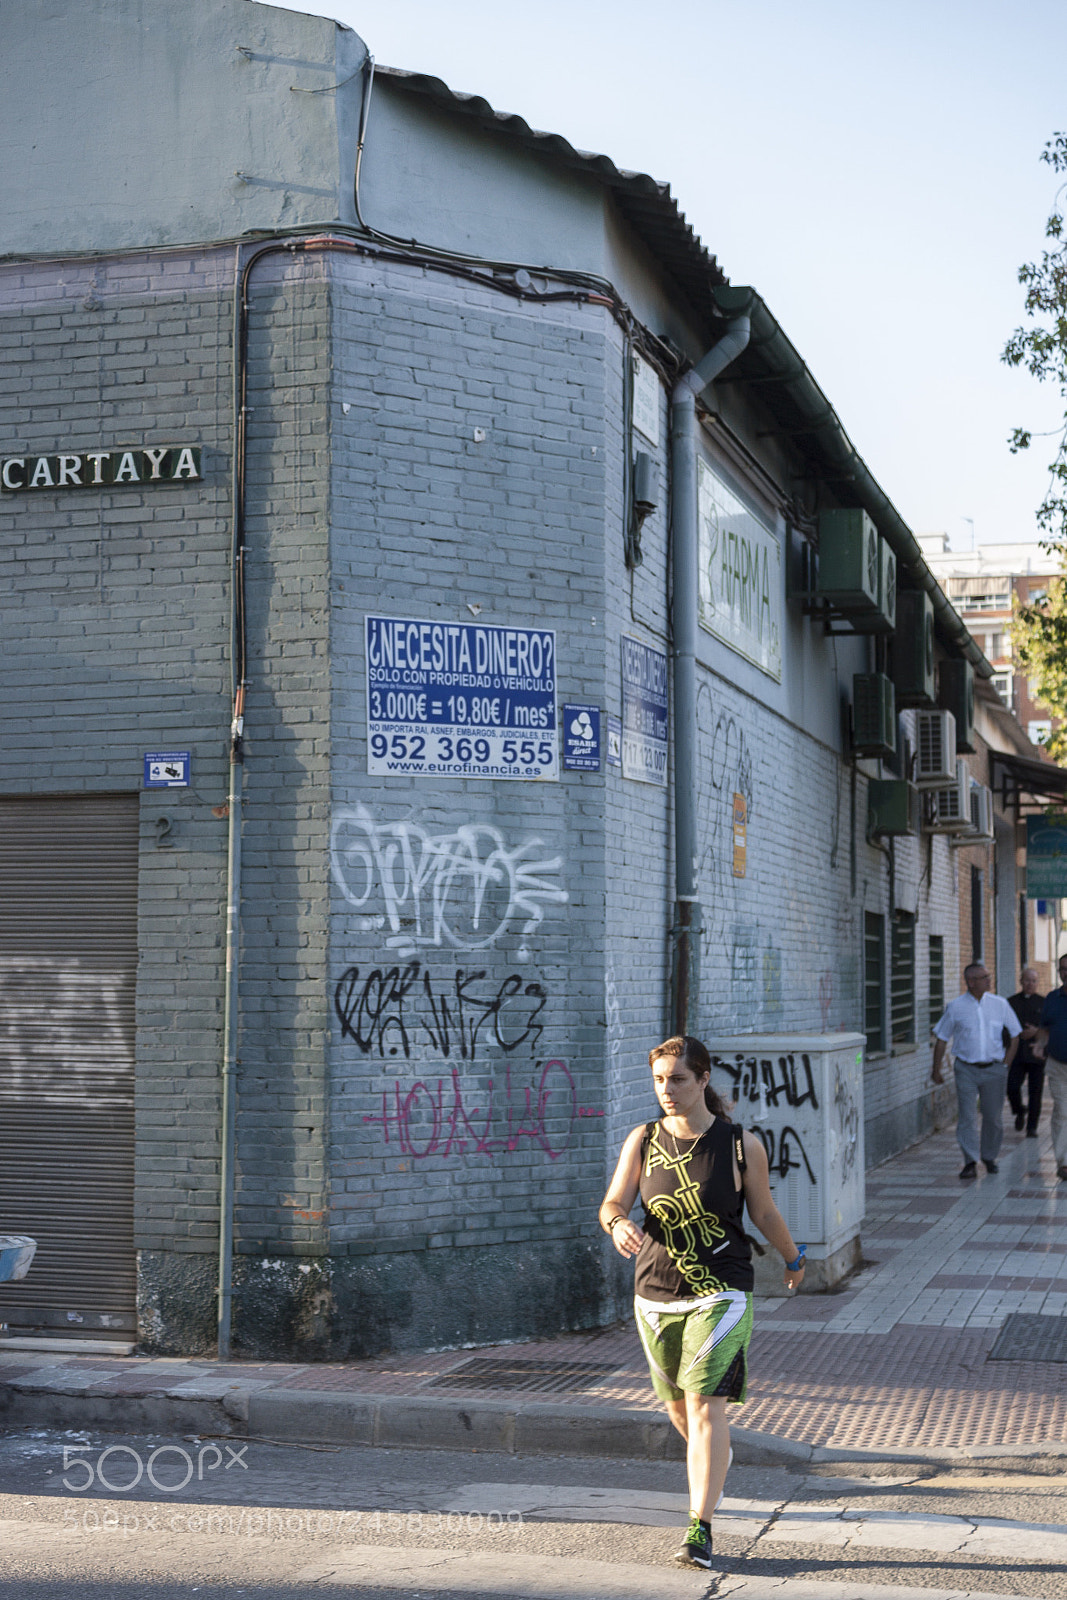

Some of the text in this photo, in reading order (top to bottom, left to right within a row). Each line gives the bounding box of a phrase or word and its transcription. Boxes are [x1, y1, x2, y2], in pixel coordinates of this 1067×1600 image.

[2, 448, 199, 489] CARTAYA
[369, 620, 553, 678] ¿NECESITA DINERO?
[369, 665, 400, 682] SÓLO
[403, 670, 427, 684] CON
[429, 671, 491, 688] PROPIEDAD
[502, 674, 554, 692] VEHÍCULO
[371, 691, 427, 721] 3.000€
[431, 701, 442, 715] =
[447, 695, 501, 726] 19,80€
[504, 698, 510, 725] /
[369, 723, 380, 732] NO
[381, 724, 413, 734] IMPORTA
[371, 734, 553, 765] 952 369 555
[387, 762, 541, 776] www.eurofinancia.es
